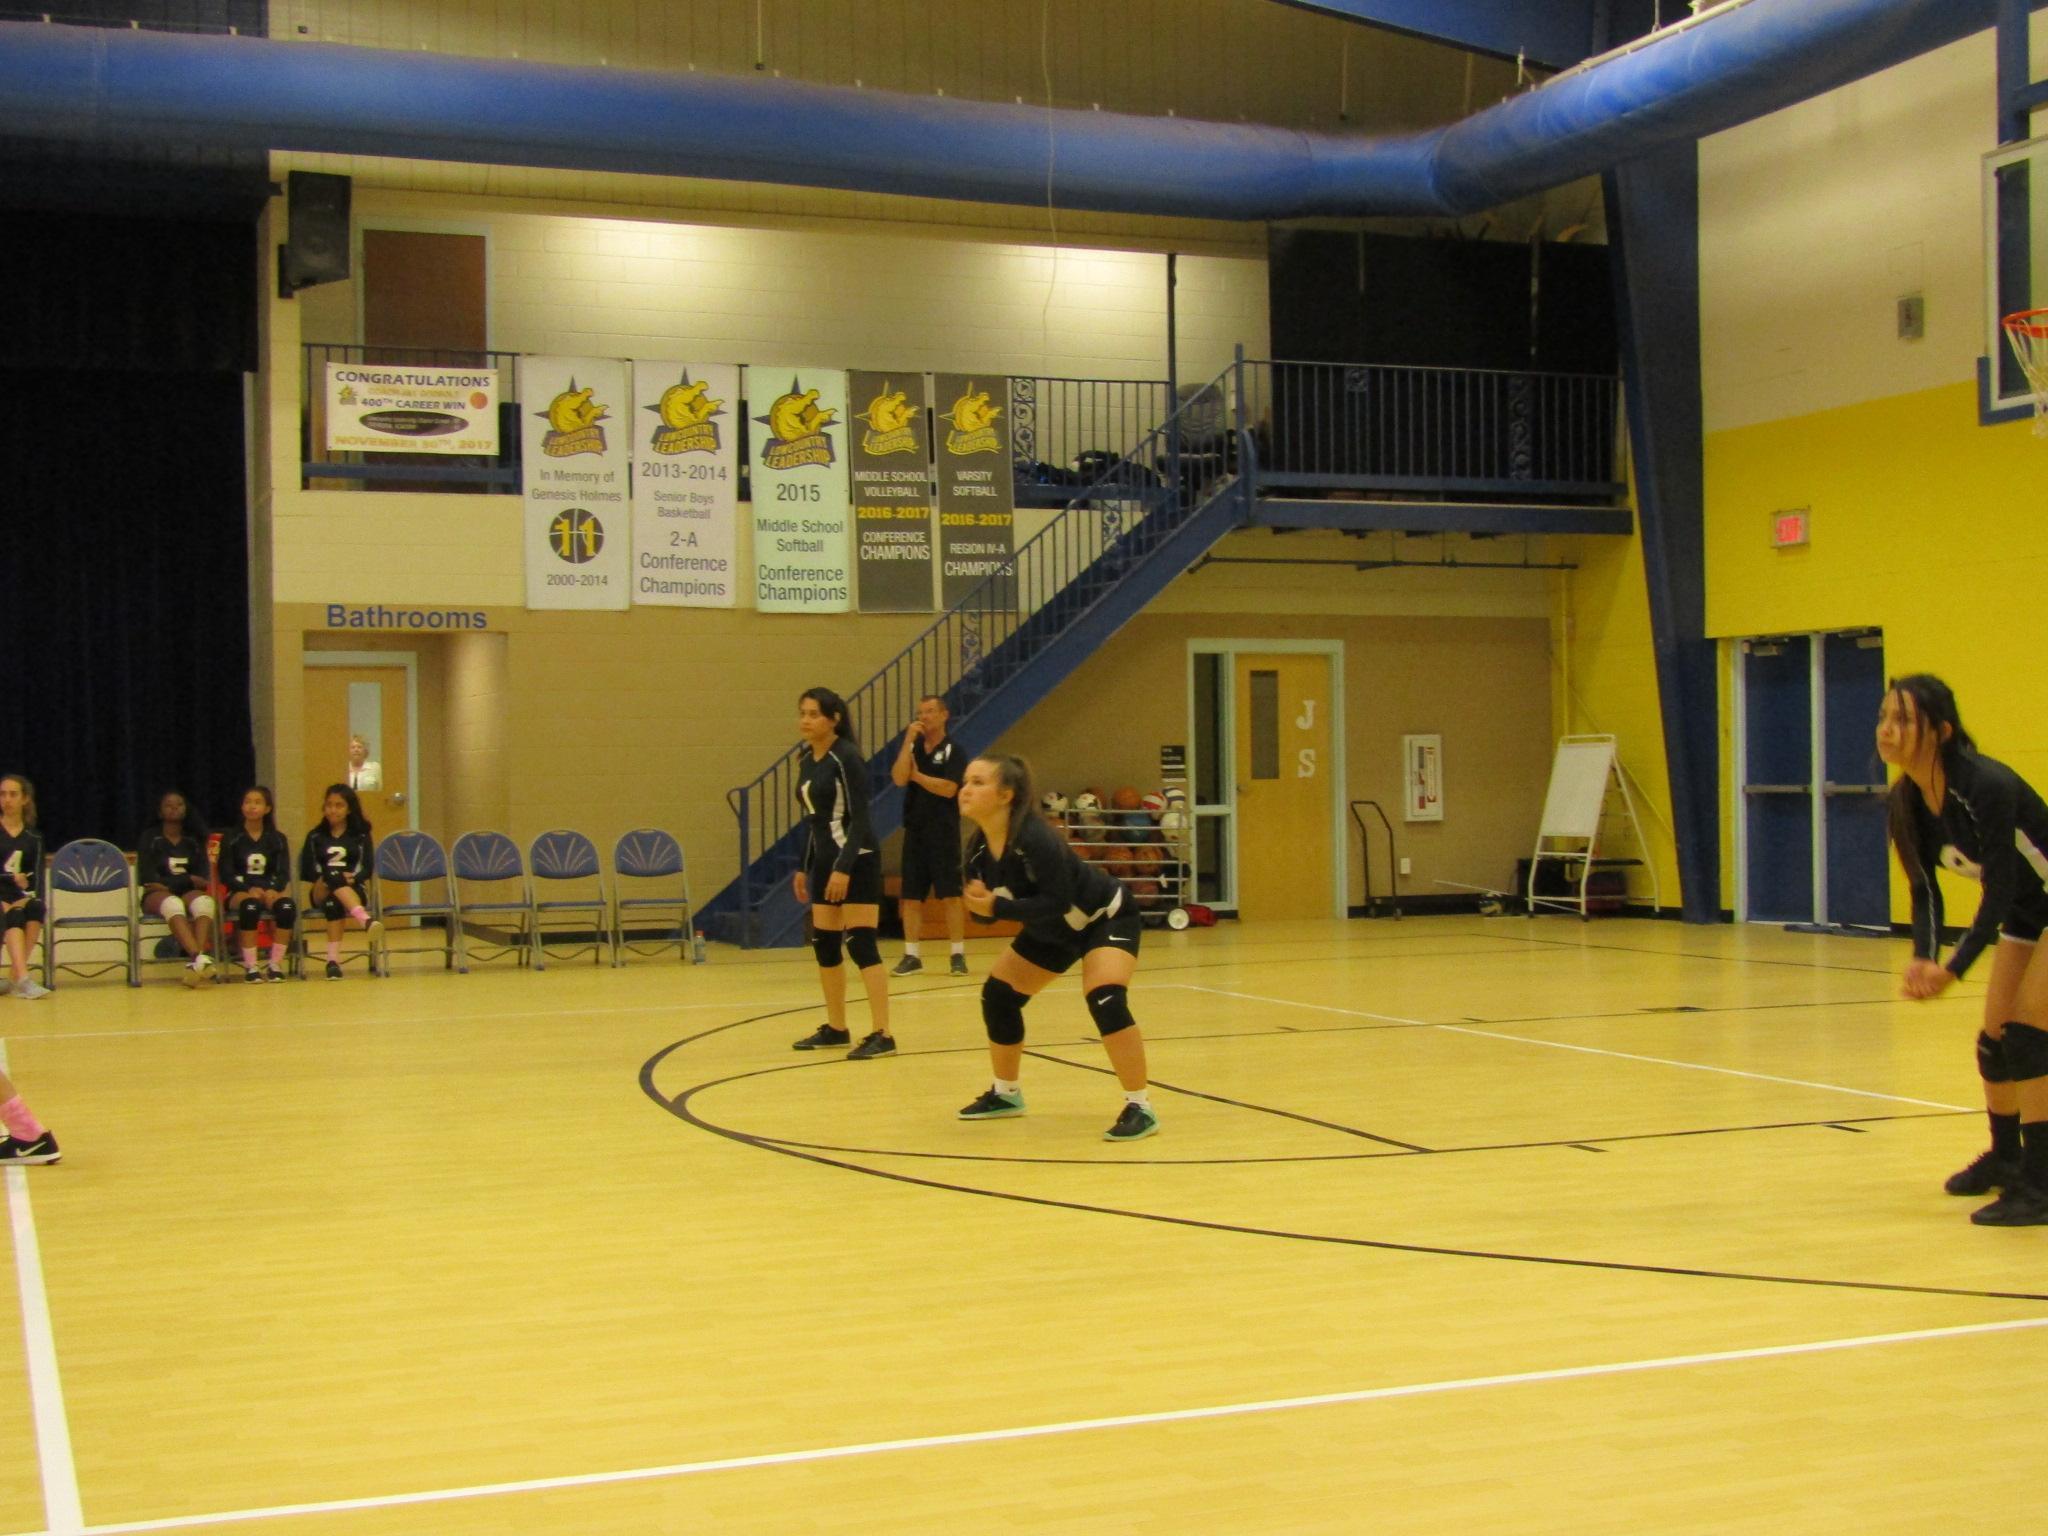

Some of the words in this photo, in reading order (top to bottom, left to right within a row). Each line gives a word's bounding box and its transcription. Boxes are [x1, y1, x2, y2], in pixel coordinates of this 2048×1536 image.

[335, 371, 490, 387] CONGRATULATIONS
[396, 400, 440, 410] CAREER
[443, 402, 466, 410] WIN
[540, 469, 549, 480] In
[554, 470, 599, 484] Memory
[603, 471, 615, 483] of
[642, 462, 727, 480] 2013-2014
[855, 472, 889, 482] MIDDLE
[891, 472, 928, 482] SCHOOL
[956, 471, 992, 481] VARSITY
[532, 489, 576, 500] Genesis
[580, 490, 622, 502] Holmes
[654, 491, 686, 503] Senior
[690, 493, 714, 505] Boys
[776, 483, 821, 502] 2015
[864, 486, 920, 497] VOLLEYBALL
[953, 486, 997, 497] SOFTBALL
[657, 507, 711, 519] Basketball
[858, 507, 930, 519] 2016-2017
[941, 514, 1013, 526] 2016-2017
[757, 519, 798, 533] Middle
[802, 520, 843, 533] School
[554, 518, 595, 557] 11
[669, 531, 698, 547] 2-A
[863, 531, 925, 543] CONFERENCE
[777, 538, 824, 552] Softball
[861, 545, 930, 560] CHAMPIONS
[950, 543, 984, 554] REGION
[640, 553, 728, 572] Conference
[547, 574, 608, 586] 2000-2014
[759, 565, 844, 581] Conference
[640, 577, 726, 597] Champions
[759, 583, 847, 604] Champions
[327, 604, 487, 629] Bathrooms
[1296, 700, 1316, 729] J
[1297, 749, 1316, 778] S
[4, 850, 22, 873] 4
[326, 846, 347, 866] 2
